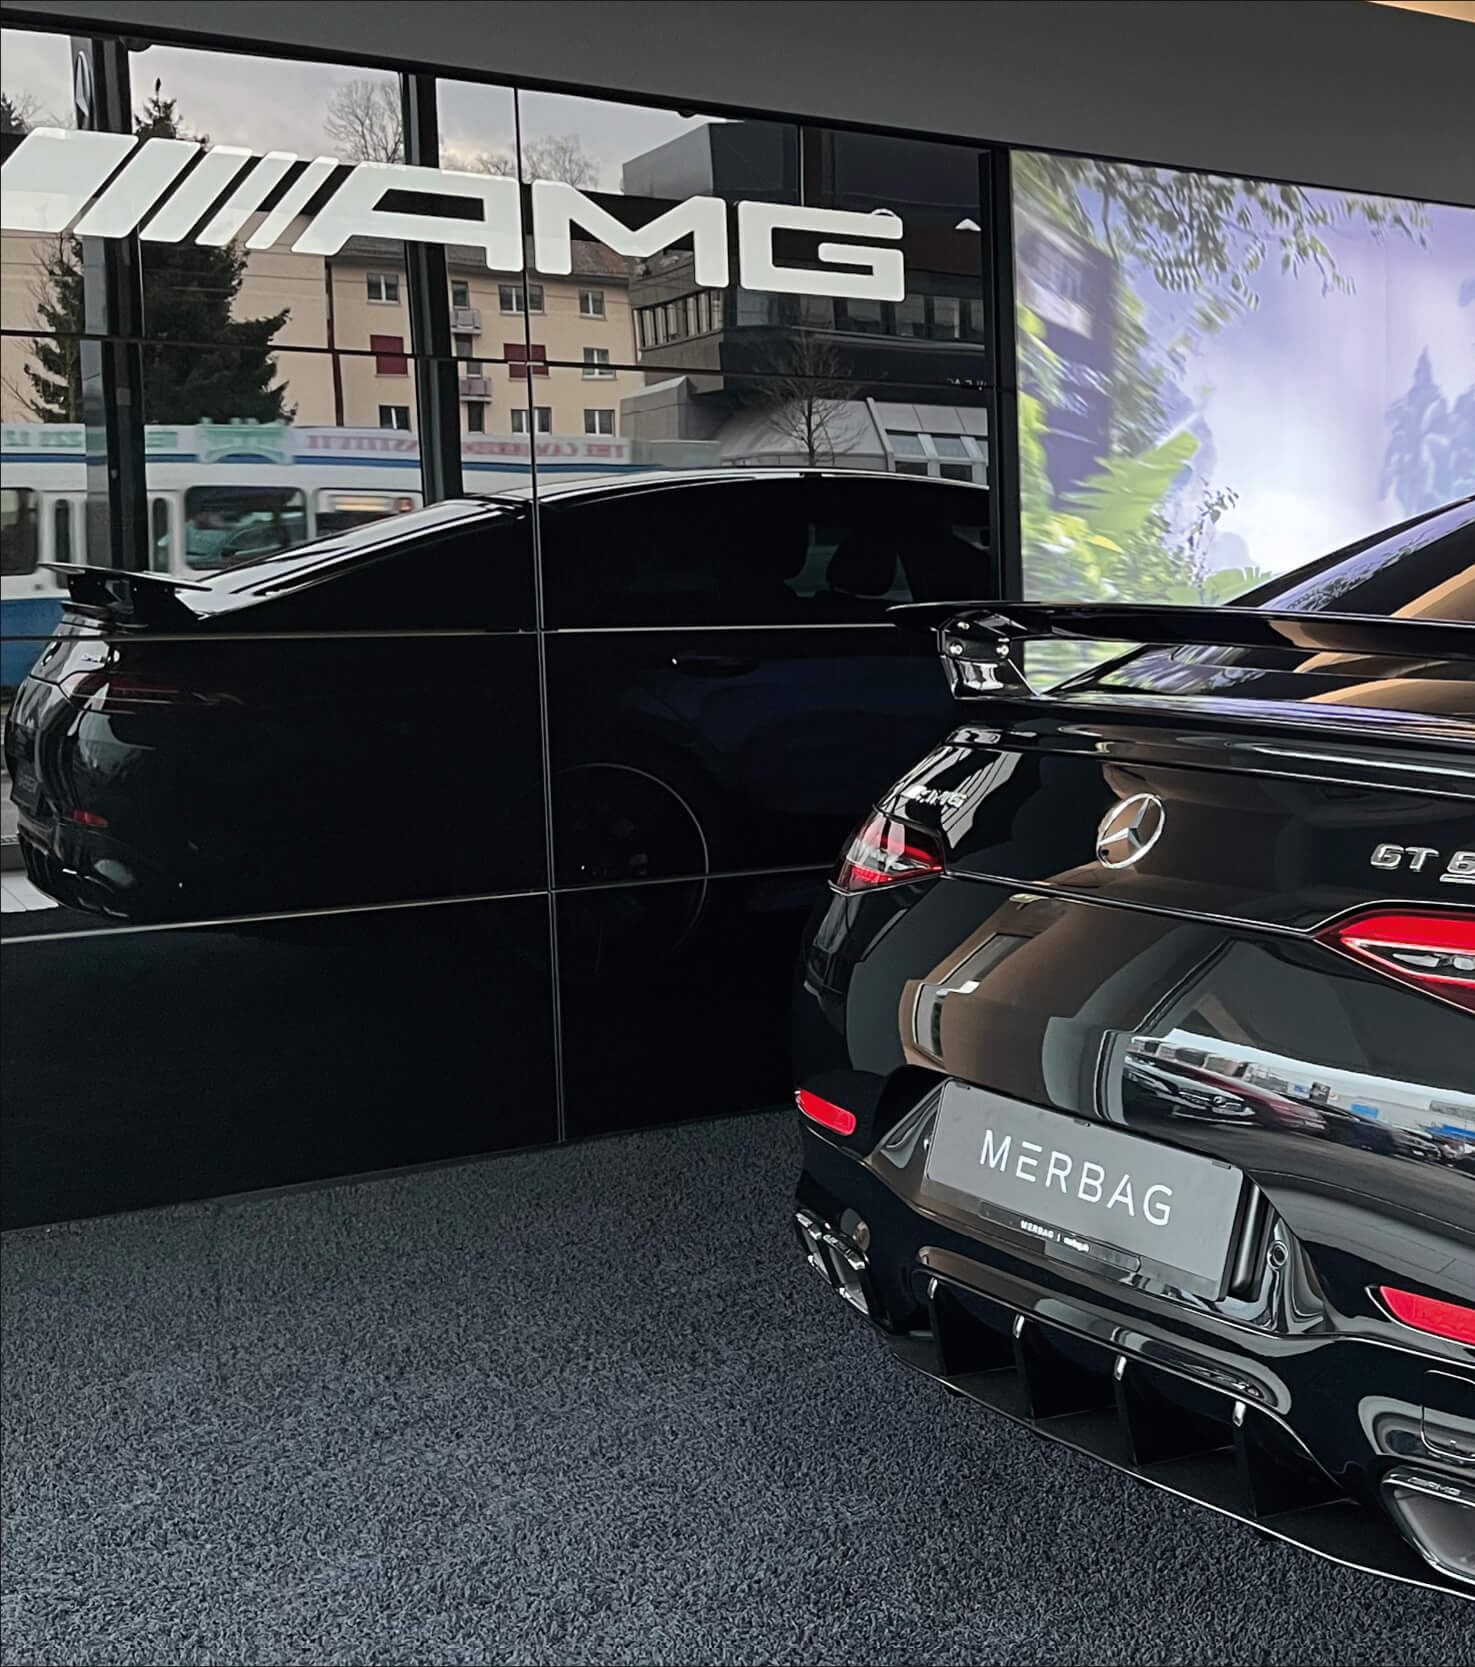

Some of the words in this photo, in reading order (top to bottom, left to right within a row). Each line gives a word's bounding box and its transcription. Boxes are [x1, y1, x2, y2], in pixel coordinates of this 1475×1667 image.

[291, 162, 906, 302] AMG
[1370, 843, 1440, 872] GT
[979, 1129, 1173, 1226] MERBAG
